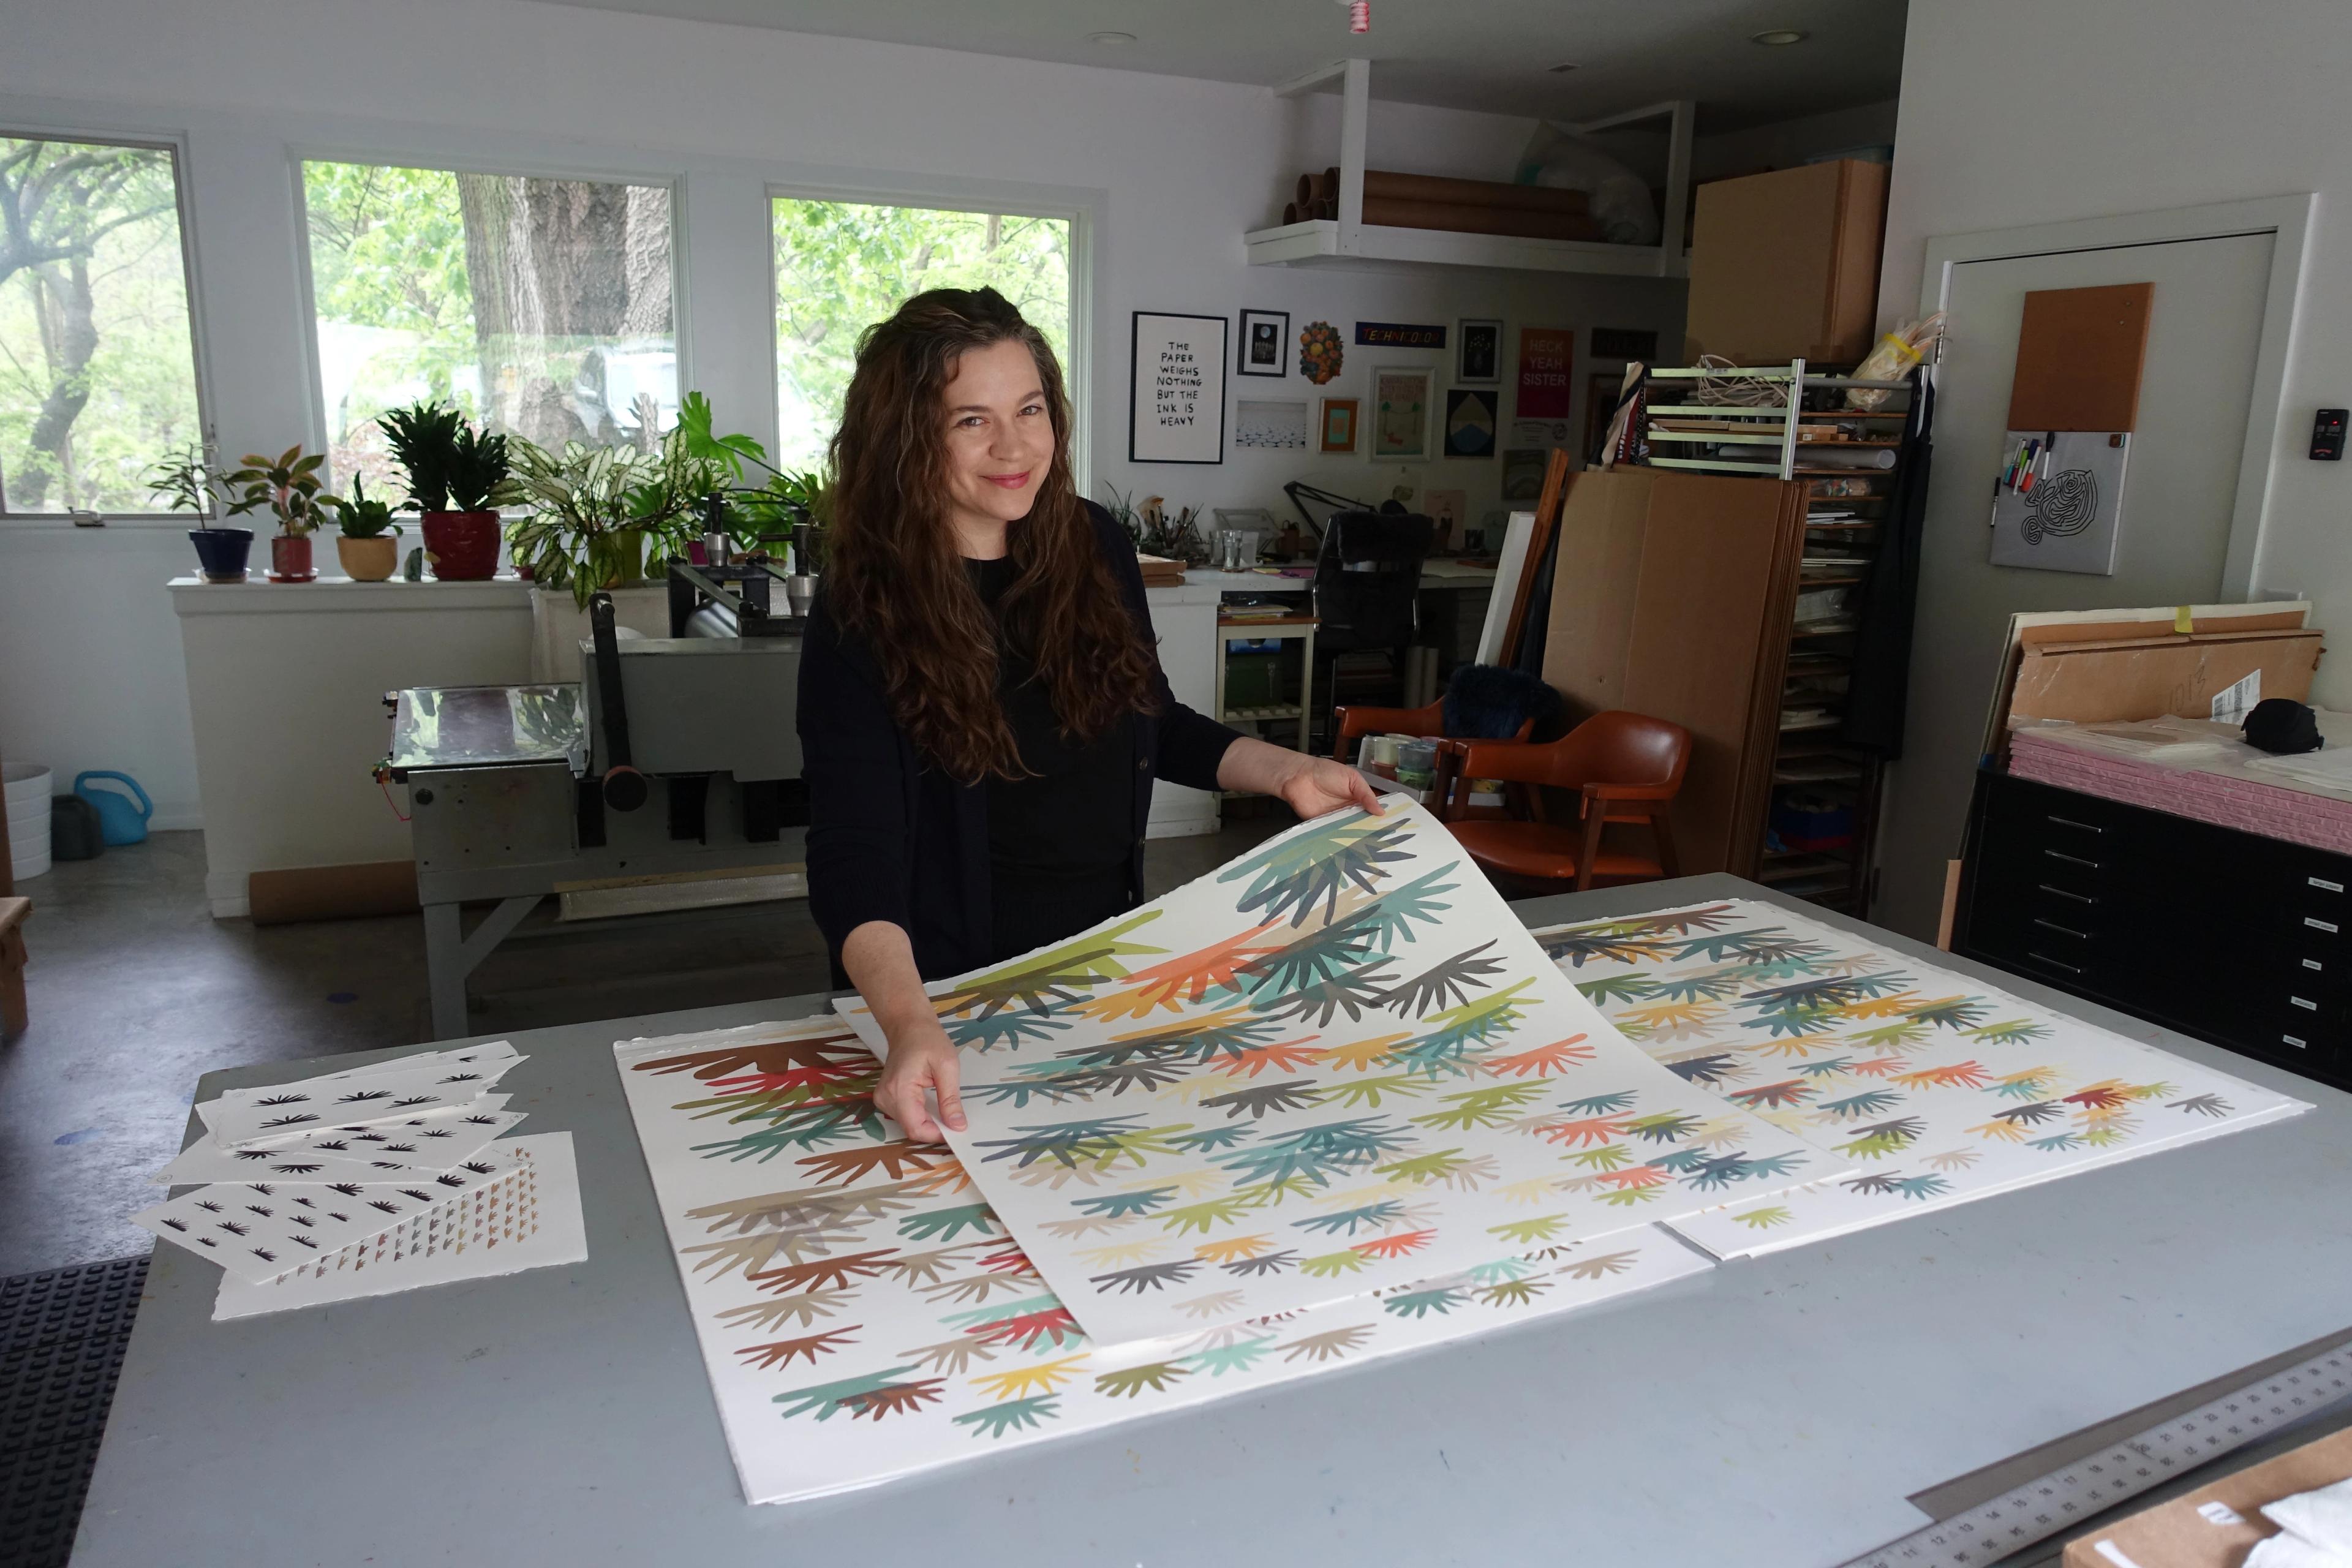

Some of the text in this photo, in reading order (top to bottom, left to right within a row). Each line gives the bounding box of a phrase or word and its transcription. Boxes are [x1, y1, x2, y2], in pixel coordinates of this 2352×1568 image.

[1362, 328, 1441, 343] TECHNICOLOR
[1168, 341, 1189, 350] THE
[1529, 338, 1564, 353] HECK
[1161, 352, 1193, 363] PAPER
[1529, 356, 1562, 369] YEAH
[1159, 366, 1199, 376] WEIGHS
[1156, 376, 1202, 386] NOTHING
[1523, 372, 1567, 386] SISTER
[1157, 390, 1198, 399] BUT THE
[1157, 403, 1194, 413] INK IS
[1160, 416, 1194, 426] HEAVY
[1903, 1549, 1918, 1558] 11
[1931, 1536, 1947, 1545] 12
[1959, 1523, 1973, 1532] 13
